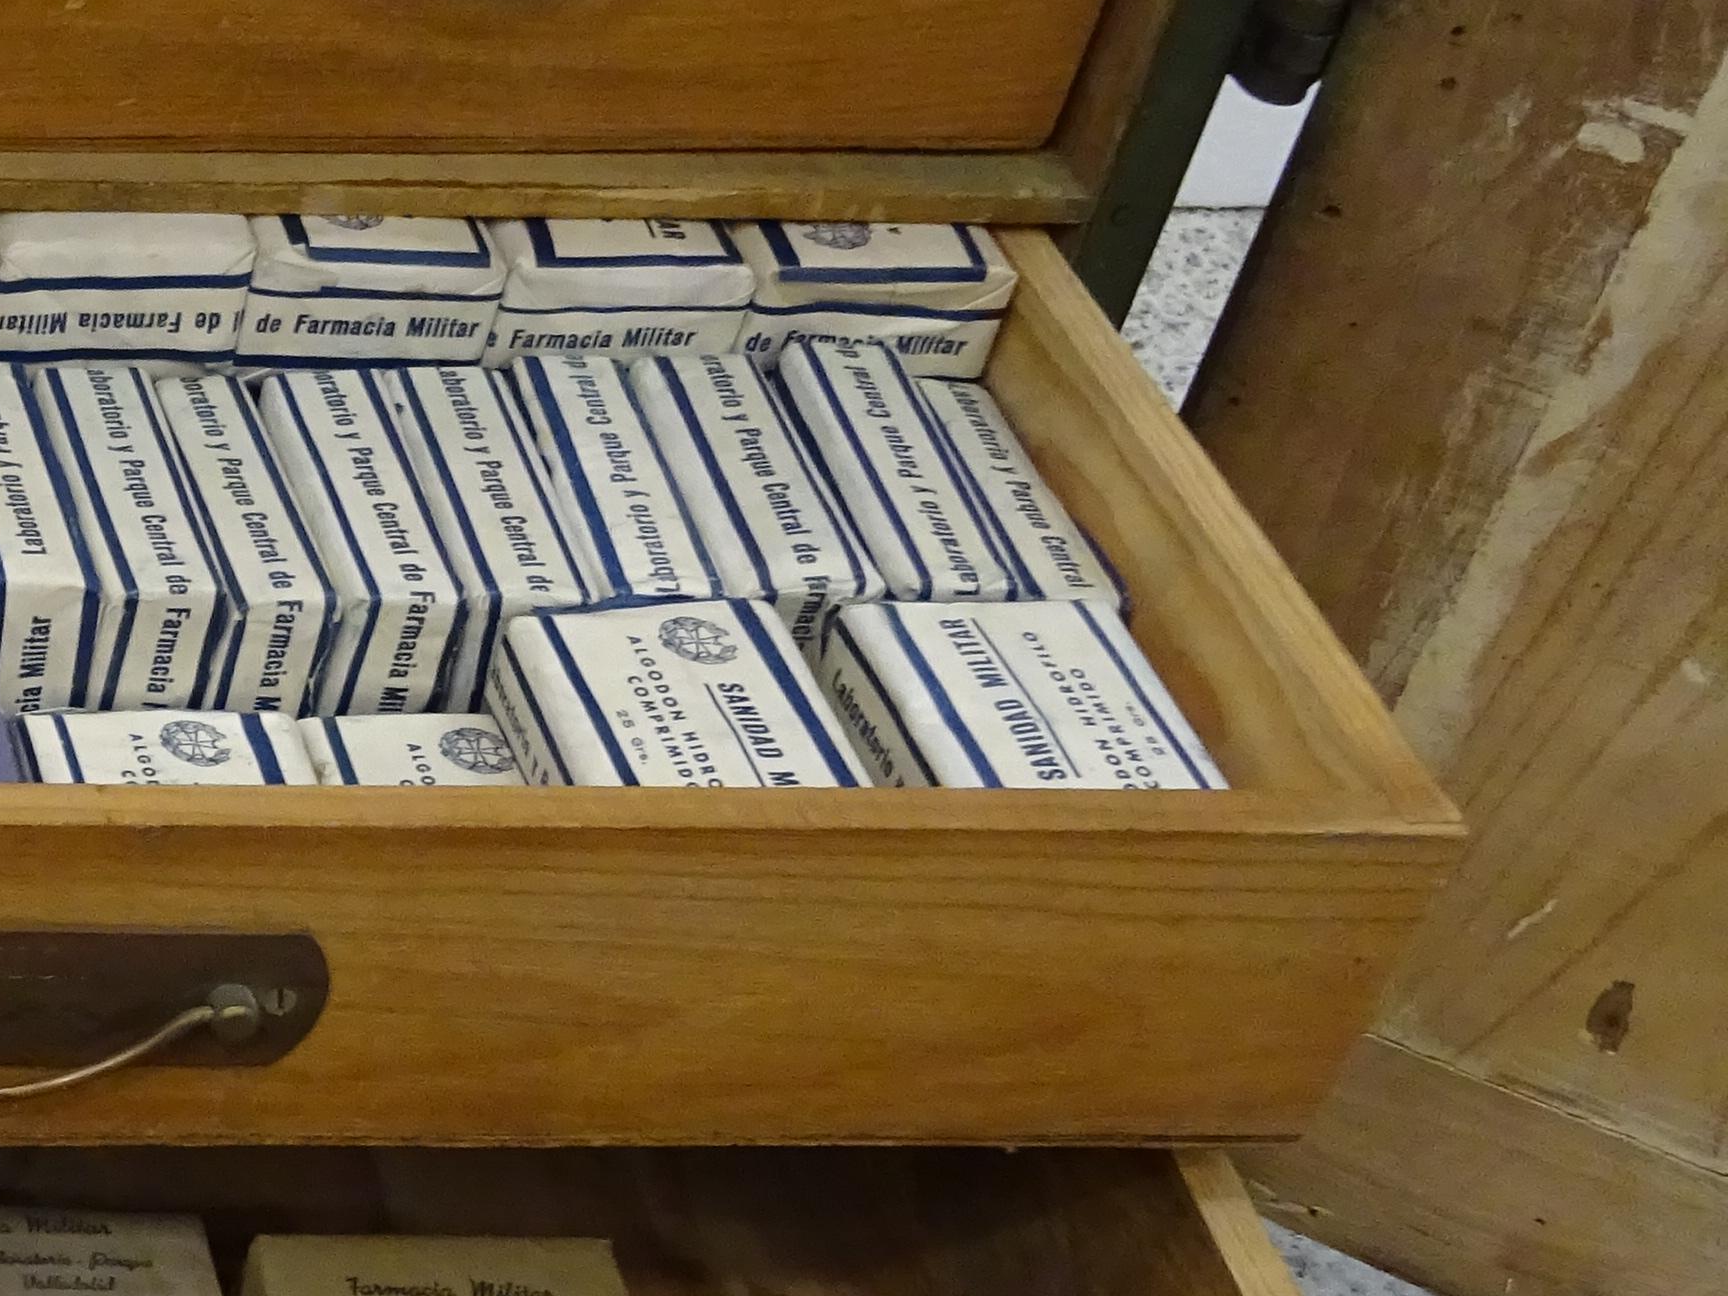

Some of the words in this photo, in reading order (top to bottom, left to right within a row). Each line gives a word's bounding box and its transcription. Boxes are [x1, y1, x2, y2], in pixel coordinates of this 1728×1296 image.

[78, 313, 182, 334] Farmacia
[256, 313, 282, 334] de
[294, 314, 396, 338] Farmacia
[406, 318, 480, 339] Militar
[509, 328, 611, 350] Farmacia
[624, 327, 698, 348] Militar
[745, 332, 773, 354] de
[896, 334, 968, 357] Militar
[568, 374, 612, 427] Central
[720, 412, 750, 422] y
[843, 365, 892, 419] Central
[106, 446, 134, 455] y
[204, 443, 231, 451] y
[334, 432, 362, 440] y
[463, 446, 490, 454] y
[599, 432, 635, 485] Parque
[734, 428, 775, 477] Parque
[881, 425, 925, 479] Parque
[118, 459, 154, 509] Parque
[217, 458, 255, 506] Parque
[347, 447, 385, 497] Parque
[476, 461, 514, 511] Parque
[624, 490, 651, 498] y
[911, 485, 938, 495] y
[948, 382, 1009, 472] Laboratorio
[990, 466, 1019, 475] y
[1005, 479, 1051, 539] Parque
[1040, 535, 1096, 589] Central
[6, 472, 46, 556] Laboratorio
[372, 502, 418, 554] Central
[768, 482, 813, 535] Central
[142, 514, 179, 566] Central
[241, 511, 280, 564] Central
[500, 516, 547, 568] Central
[633, 504, 682, 595] Laboratorio
[793, 542, 822, 564] de
[917, 499, 980, 596] Laboratorio
[165, 574, 188, 596] de
[268, 570, 292, 589] de
[401, 564, 427, 582] de
[527, 576, 555, 593] de
[18, 615, 52, 678] Militar
[147, 607, 191, 694] Farmacia
[259, 600, 303, 688] Farmacia
[388, 590, 436, 680] Farmacia
[940, 618, 1008, 689] MILITAR
[626, 635, 687, 722] ALGODON
[1022, 631, 1096, 727] HIDROFILO
[716, 682, 784, 759] SANIDAD
[995, 698, 1067, 780] SANIDAD
